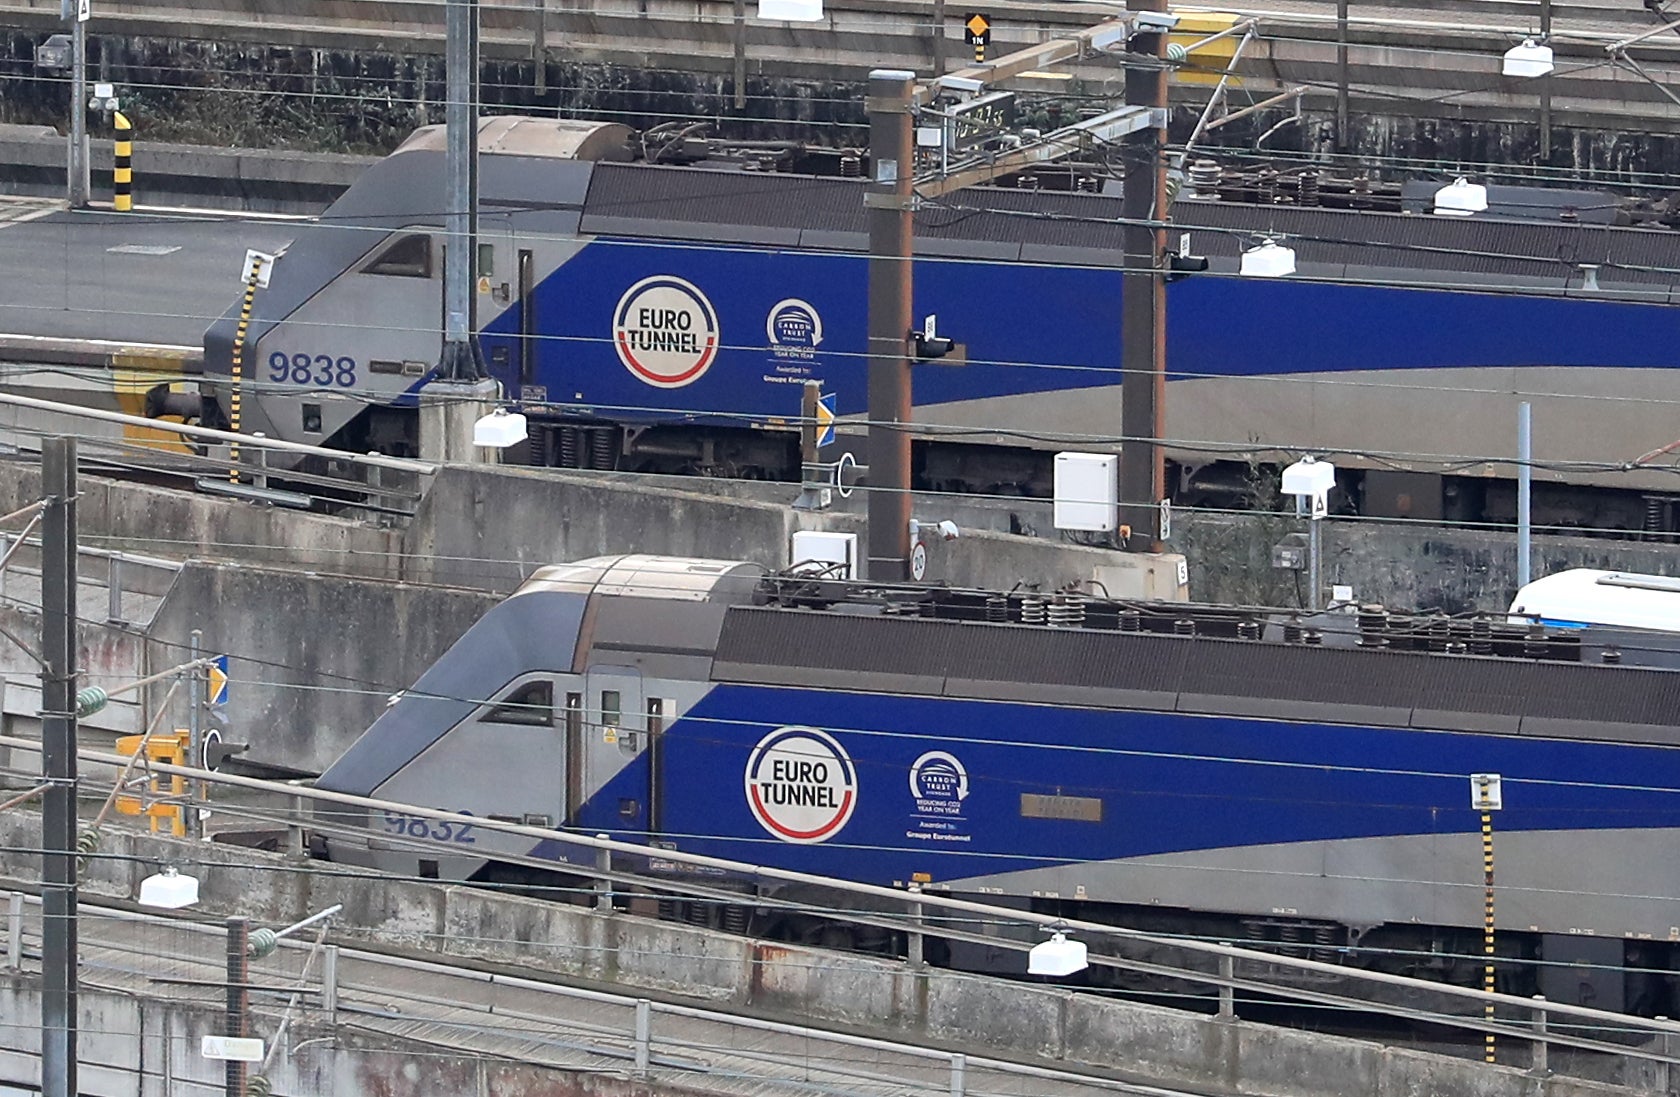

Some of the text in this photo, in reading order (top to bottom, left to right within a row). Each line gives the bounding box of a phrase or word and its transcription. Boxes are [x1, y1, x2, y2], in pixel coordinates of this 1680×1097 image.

[972, 36, 984, 45] 1N
[639, 308, 692, 331] EURO
[778, 322, 812, 331] CARBON
[783, 329, 806, 337] TRUST
[628, 329, 702, 355] TUNNEL
[268, 351, 357, 388] 9838
[914, 553, 924, 572] 20
[1180, 565, 1186, 580] 5
[773, 759, 828, 784] EURO
[921, 775, 957, 784] CARBON
[926, 783, 951, 791] TRUST
[761, 782, 838, 809] TUNNEL
[917, 805, 933, 813] YEAR
[944, 807, 961, 815] YEAR
[906, 831, 971, 842] Groupe Eurotunnel
